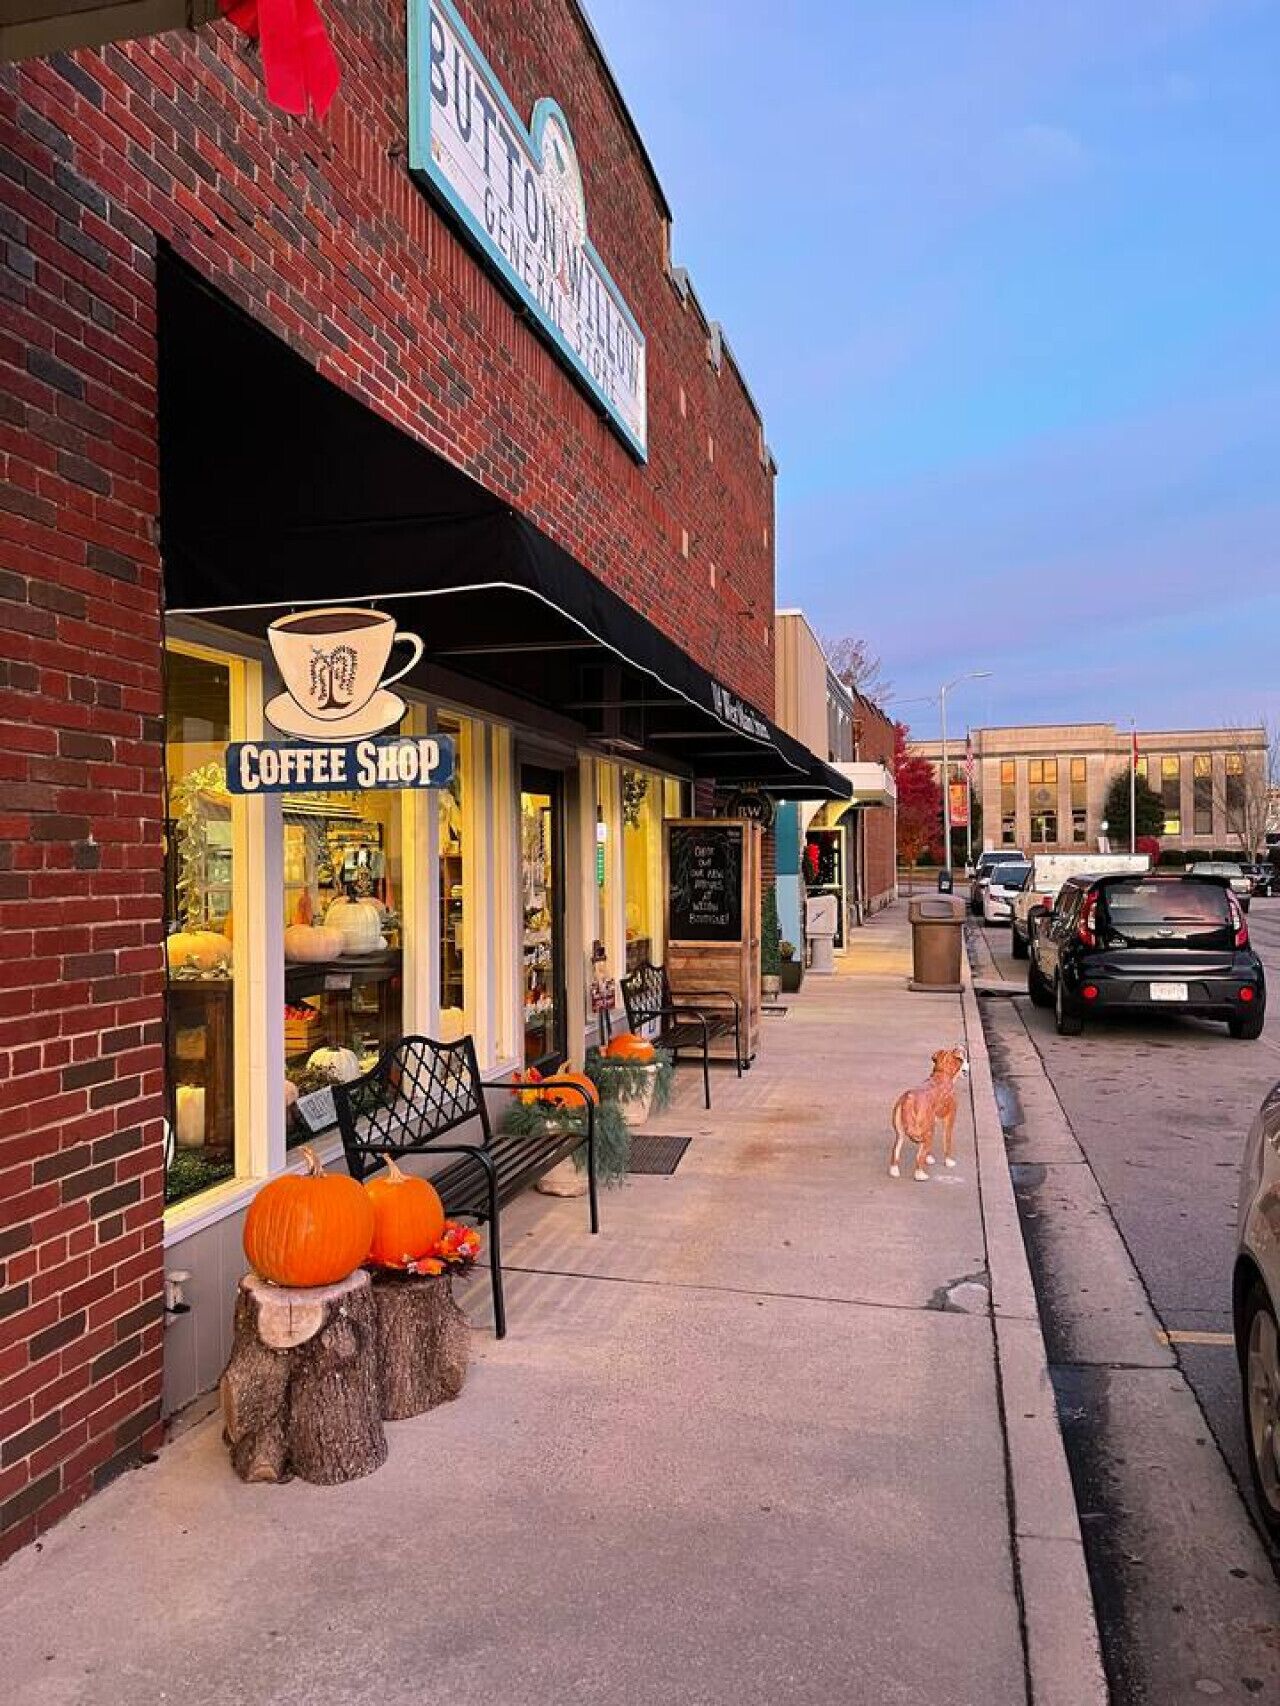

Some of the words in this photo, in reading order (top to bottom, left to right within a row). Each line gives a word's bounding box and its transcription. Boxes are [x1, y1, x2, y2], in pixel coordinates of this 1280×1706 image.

[430, 15, 557, 266] BUTTON
[562, 230, 639, 397] WILLOW
[484, 186, 565, 334] GENERAL
[575, 319, 618, 406] STORE
[240, 743, 347, 790] COFFEE
[356, 738, 440, 788] SHOP
